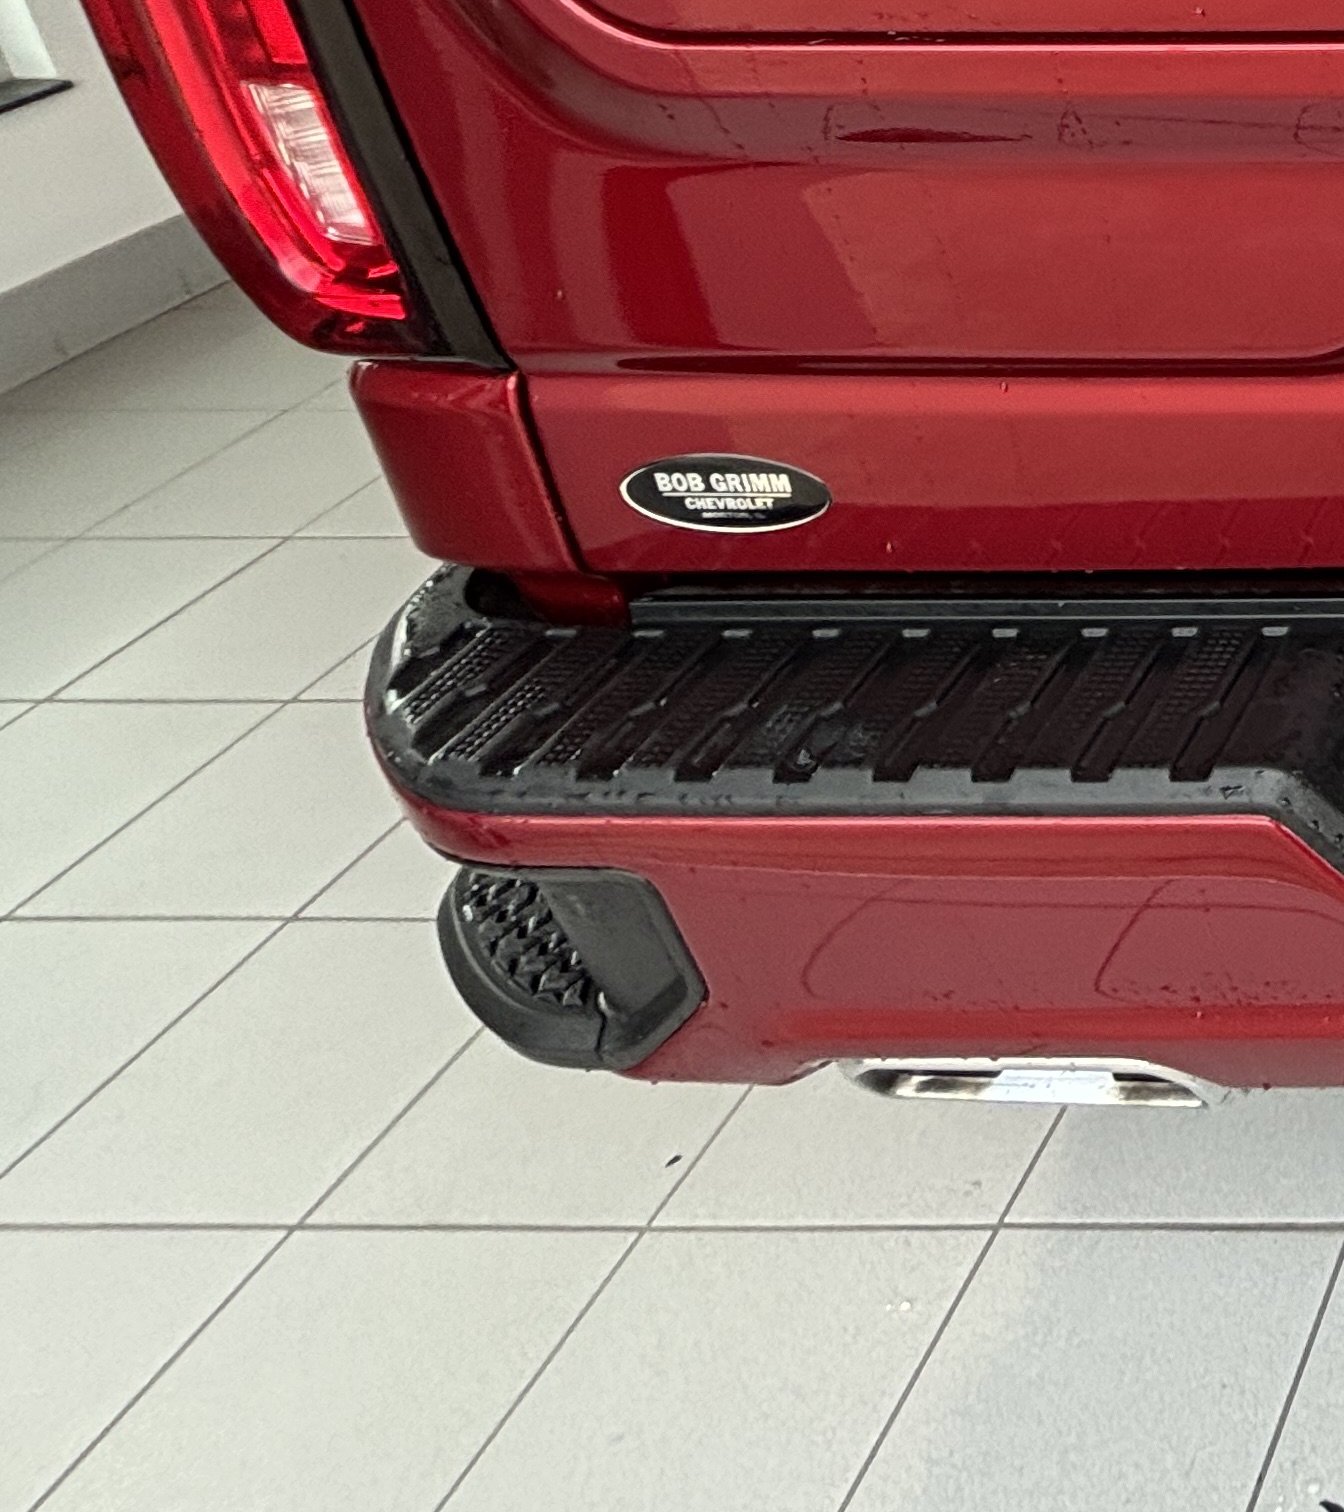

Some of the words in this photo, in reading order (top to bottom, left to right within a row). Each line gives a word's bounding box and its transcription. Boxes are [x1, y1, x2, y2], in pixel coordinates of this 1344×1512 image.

[653, 472, 706, 493] BOB
[708, 472, 793, 494] GRIMM
[684, 497, 775, 511] CHEVROLET
